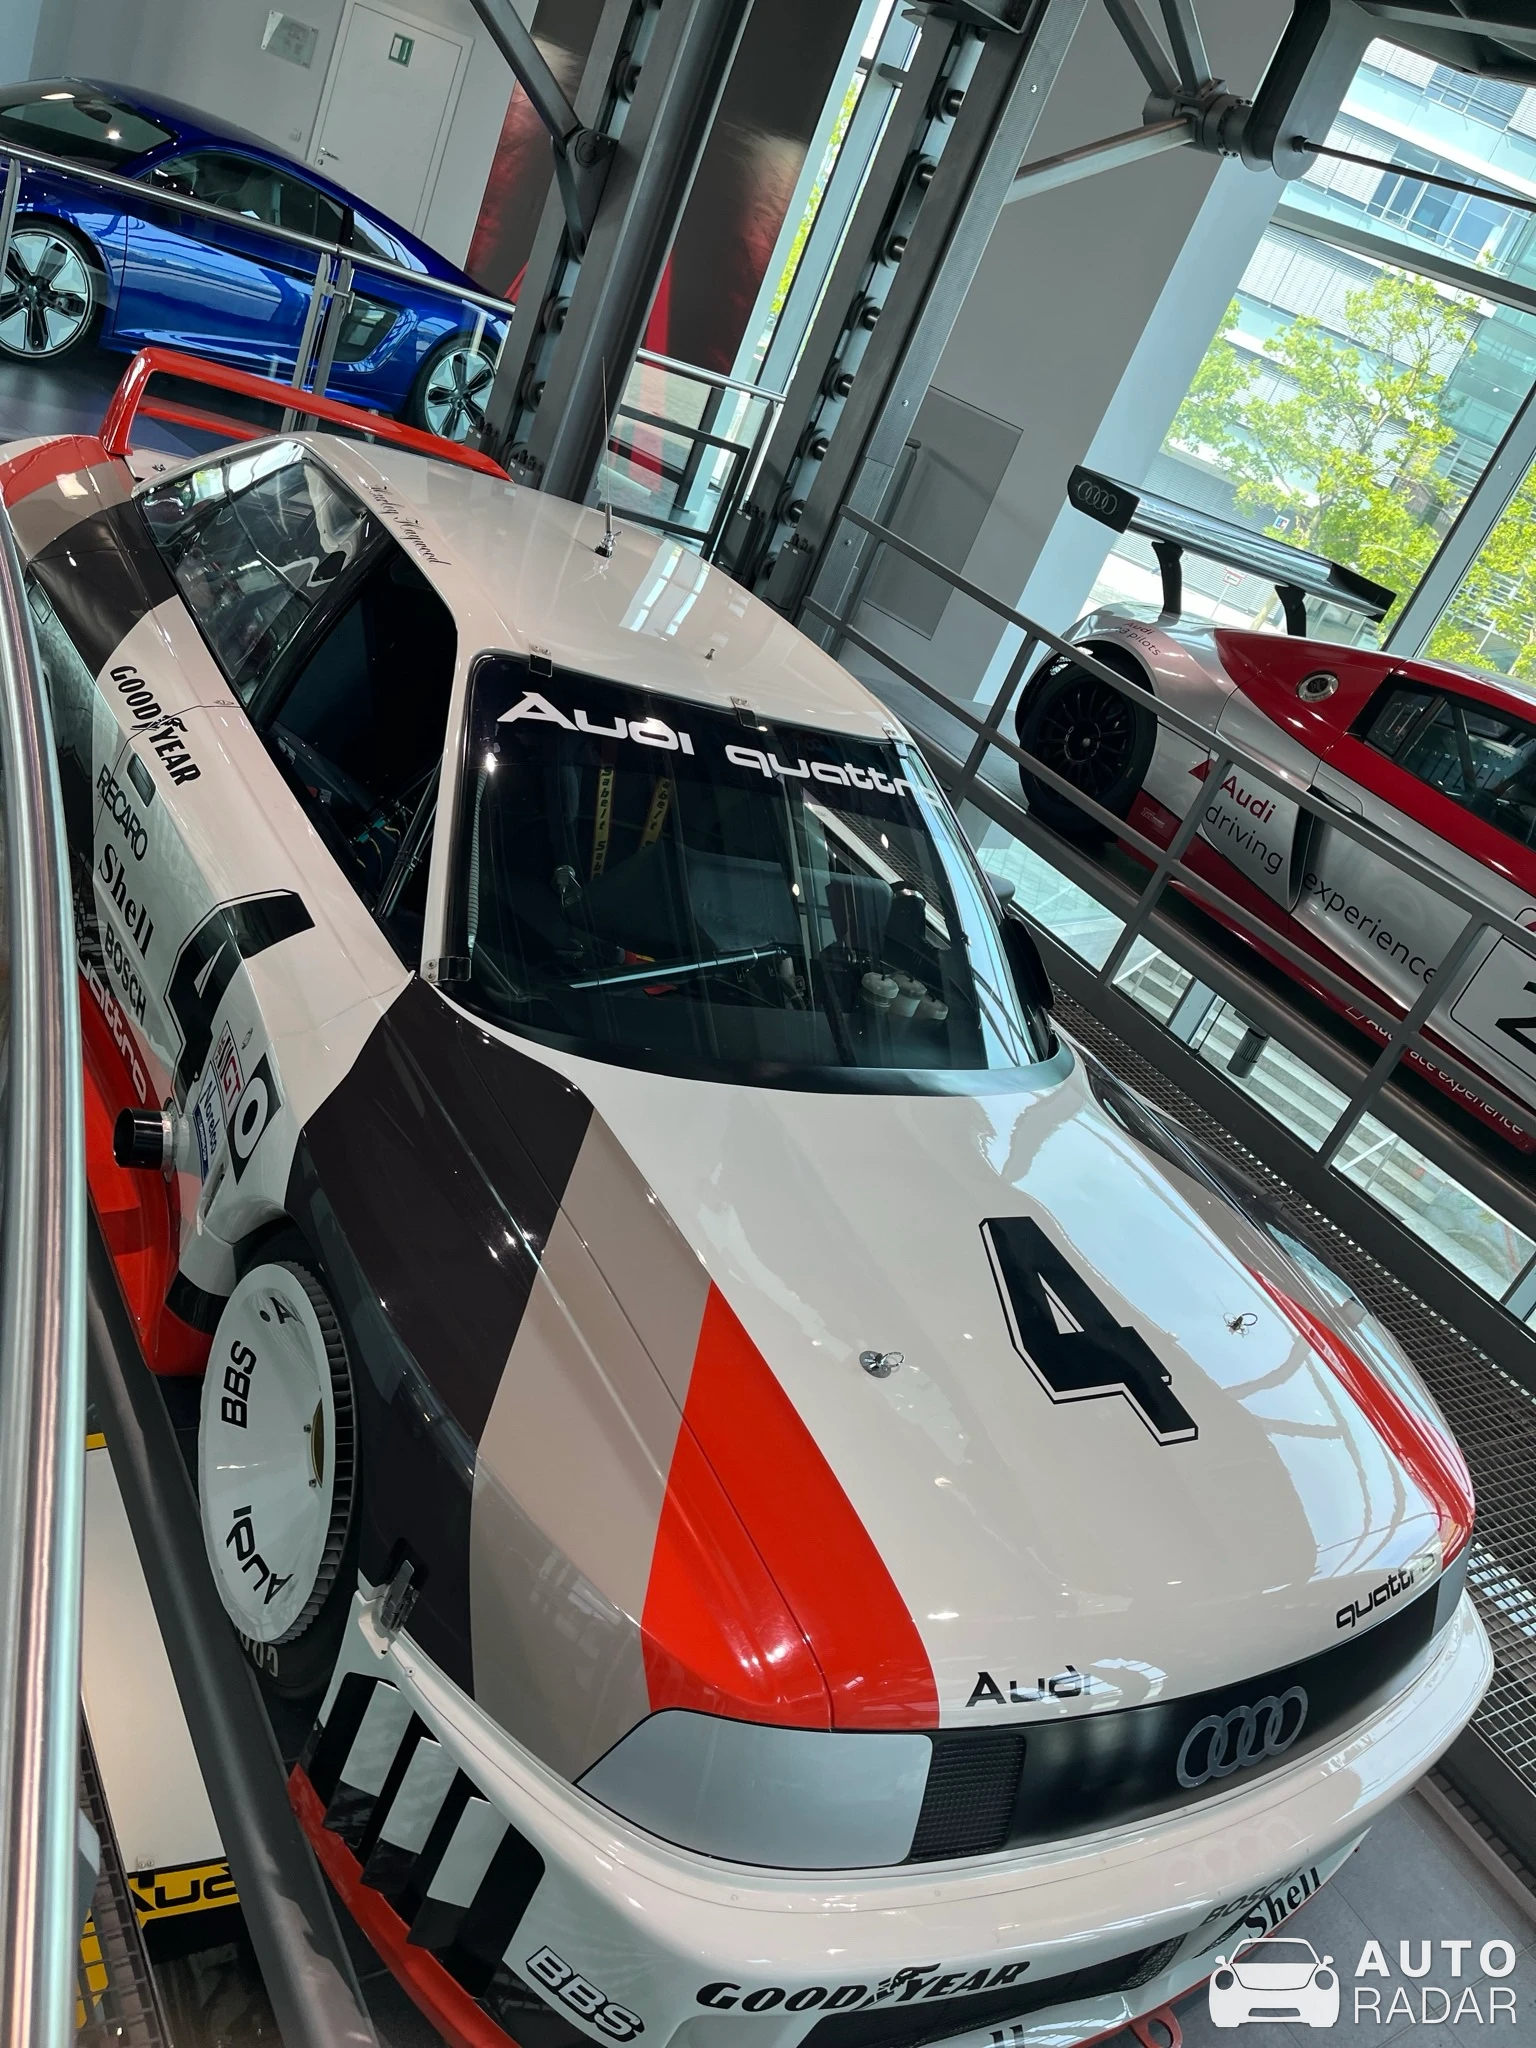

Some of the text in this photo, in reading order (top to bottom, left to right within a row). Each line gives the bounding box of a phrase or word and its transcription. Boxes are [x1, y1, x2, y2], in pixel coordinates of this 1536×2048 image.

[393, 516, 452, 566] Haywood
[1128, 632, 1162, 656] pilots
[97, 764, 148, 861] RECARO
[1220, 775, 1276, 824] Audi
[98, 844, 154, 960] Shell
[1205, 806, 1437, 984] driving experience
[105, 922, 147, 1026] BOSCH
[199, 1080, 217, 1156] Norelco
[979, 1216, 1198, 1447] 4
[221, 1340, 257, 1429] BBS
[1244, 1867, 1321, 1942] Shell
[526, 1945, 645, 2042] BBS
